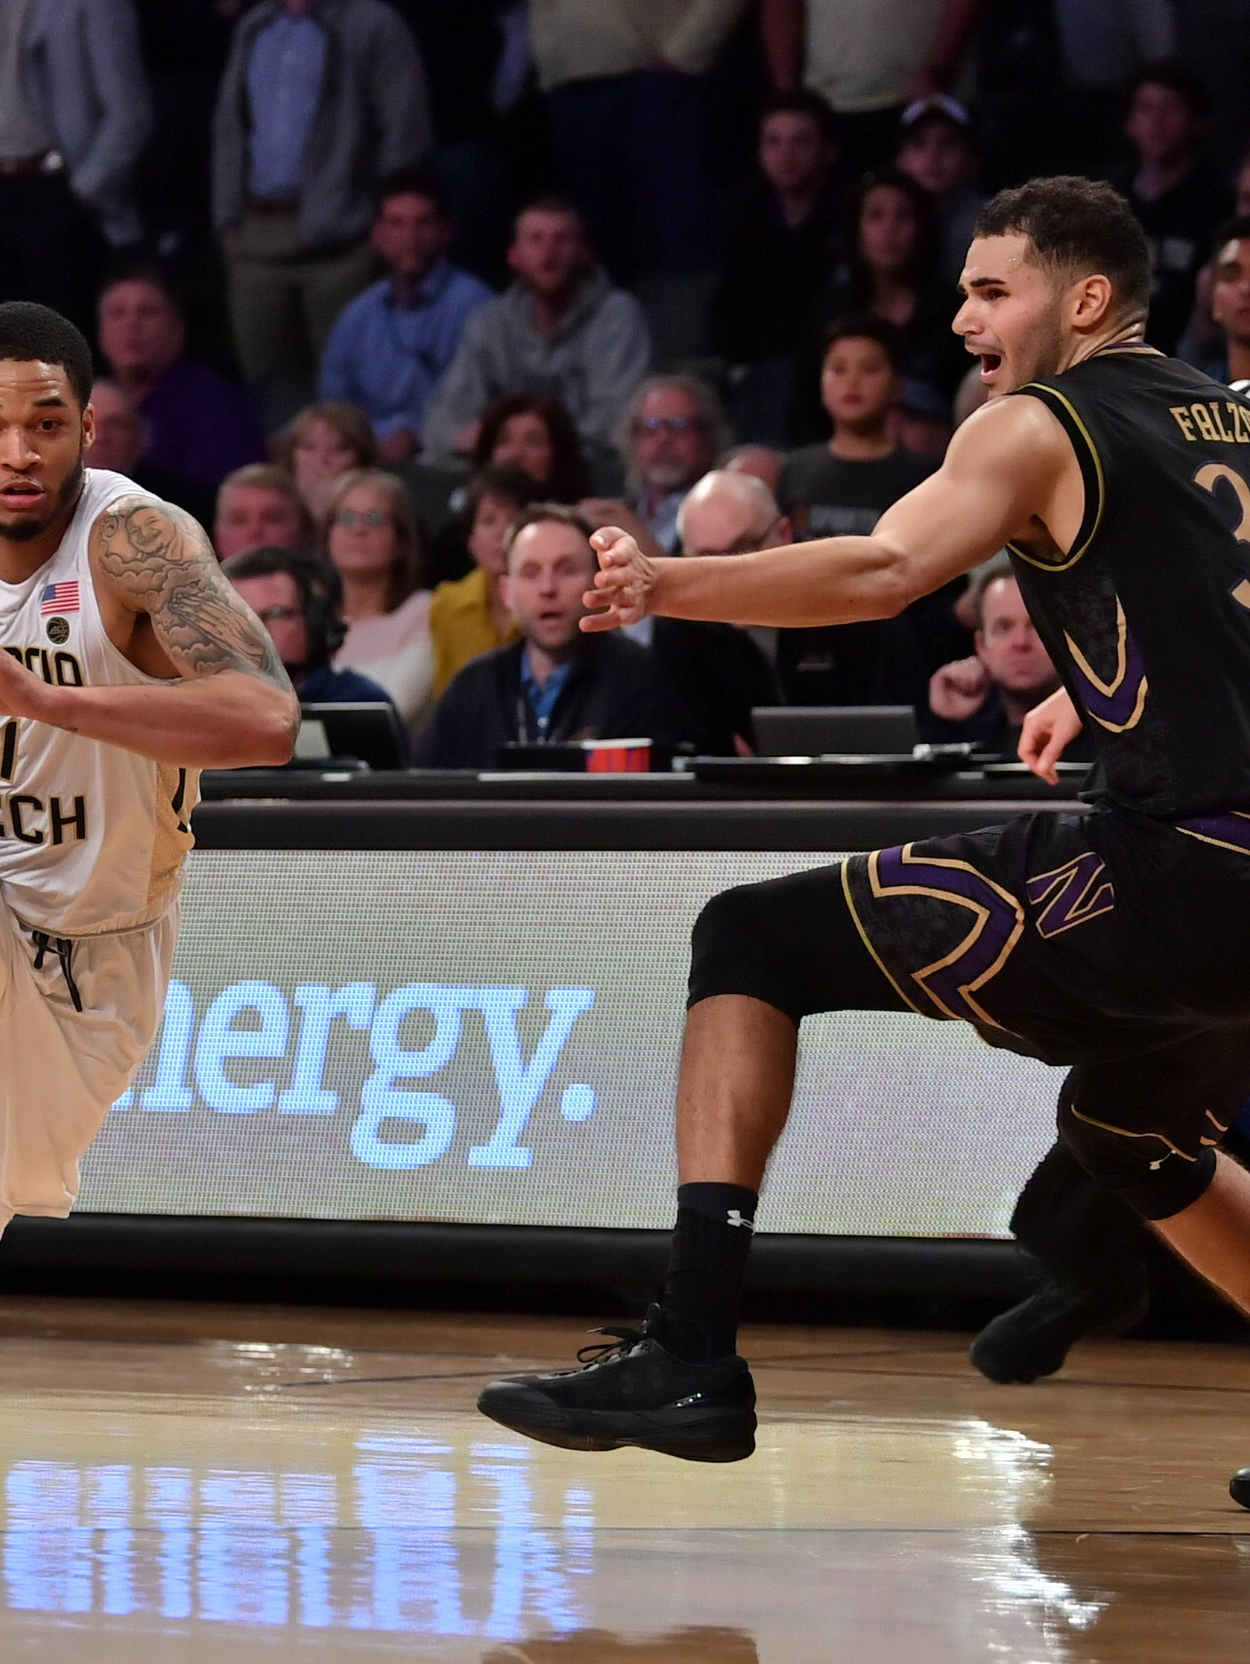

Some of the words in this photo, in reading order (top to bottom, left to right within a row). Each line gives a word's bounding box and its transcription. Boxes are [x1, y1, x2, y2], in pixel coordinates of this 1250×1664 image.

[0, 719, 18, 782] 1
[1026, 850, 1115, 940] N
[111, 977, 597, 1169] nergy.
